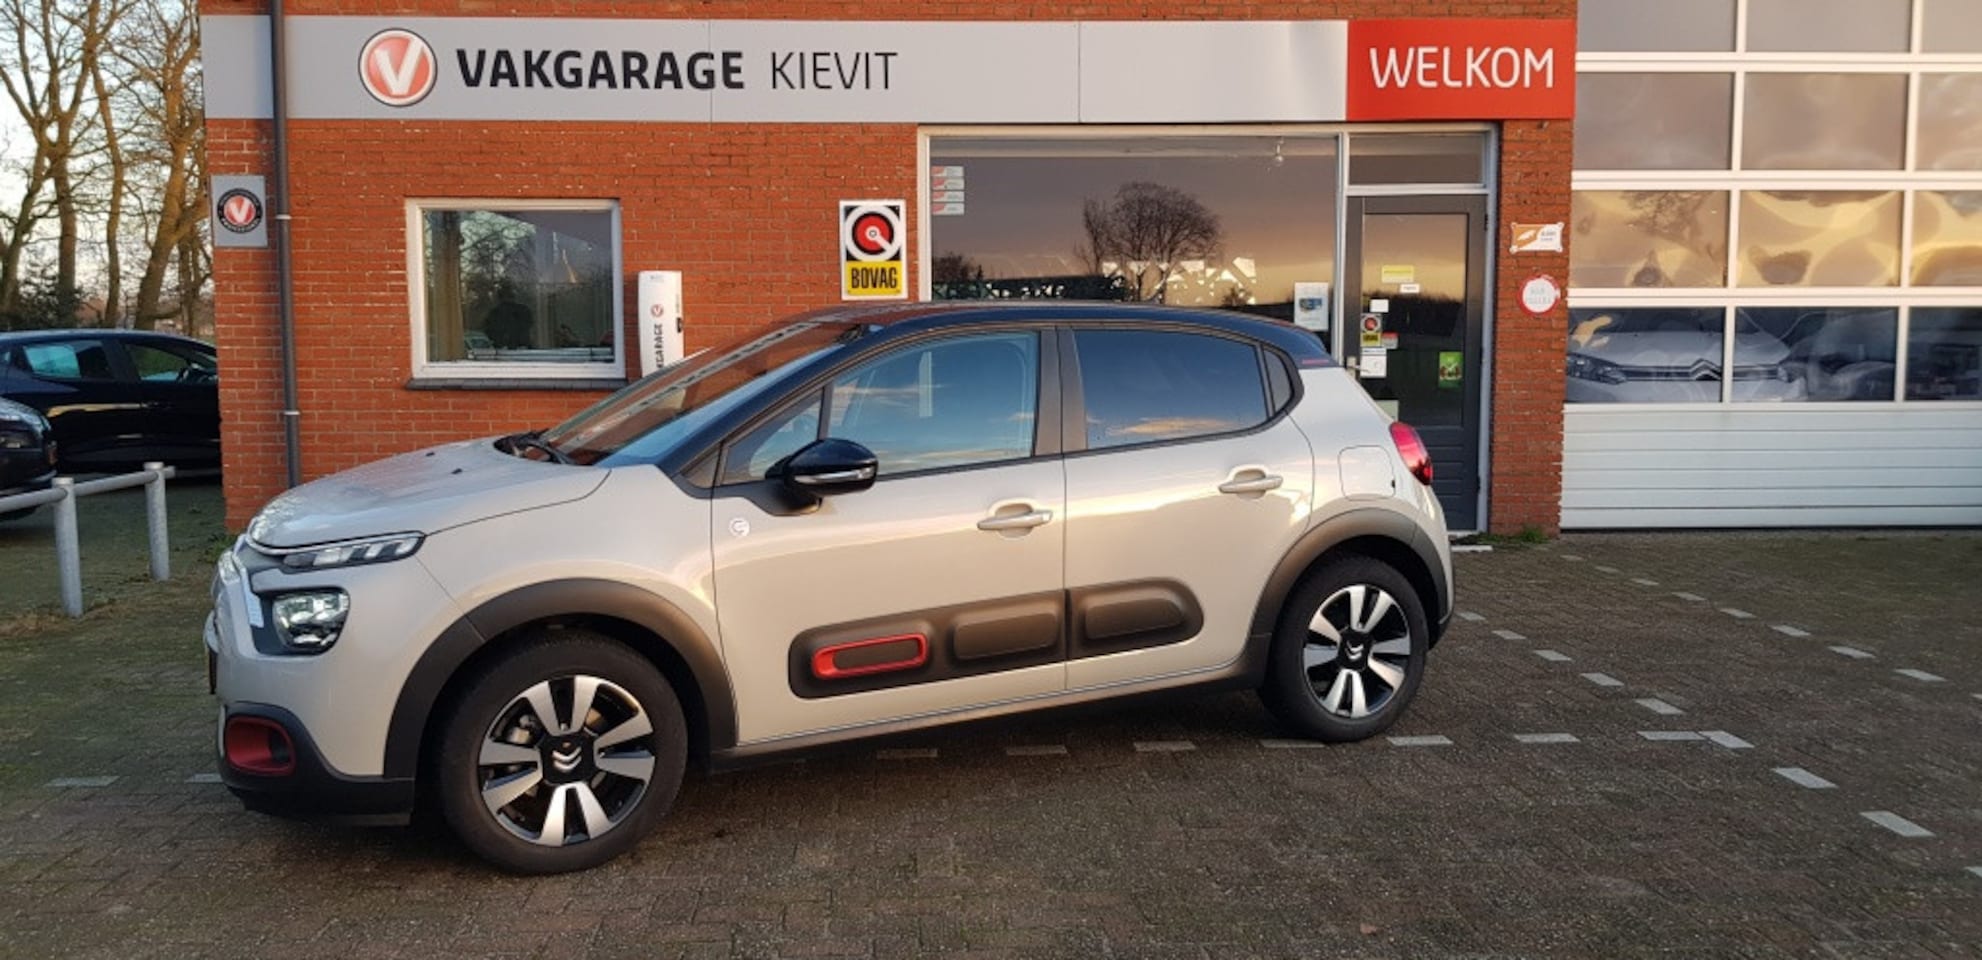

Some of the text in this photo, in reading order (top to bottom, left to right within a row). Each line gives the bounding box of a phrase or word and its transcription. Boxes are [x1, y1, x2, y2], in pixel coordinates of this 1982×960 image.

[456, 49, 898, 90] VAKGARAGE KIEVIT
[1369, 46, 1554, 88] WELKOM
[851, 267, 897, 289] BOVAG
